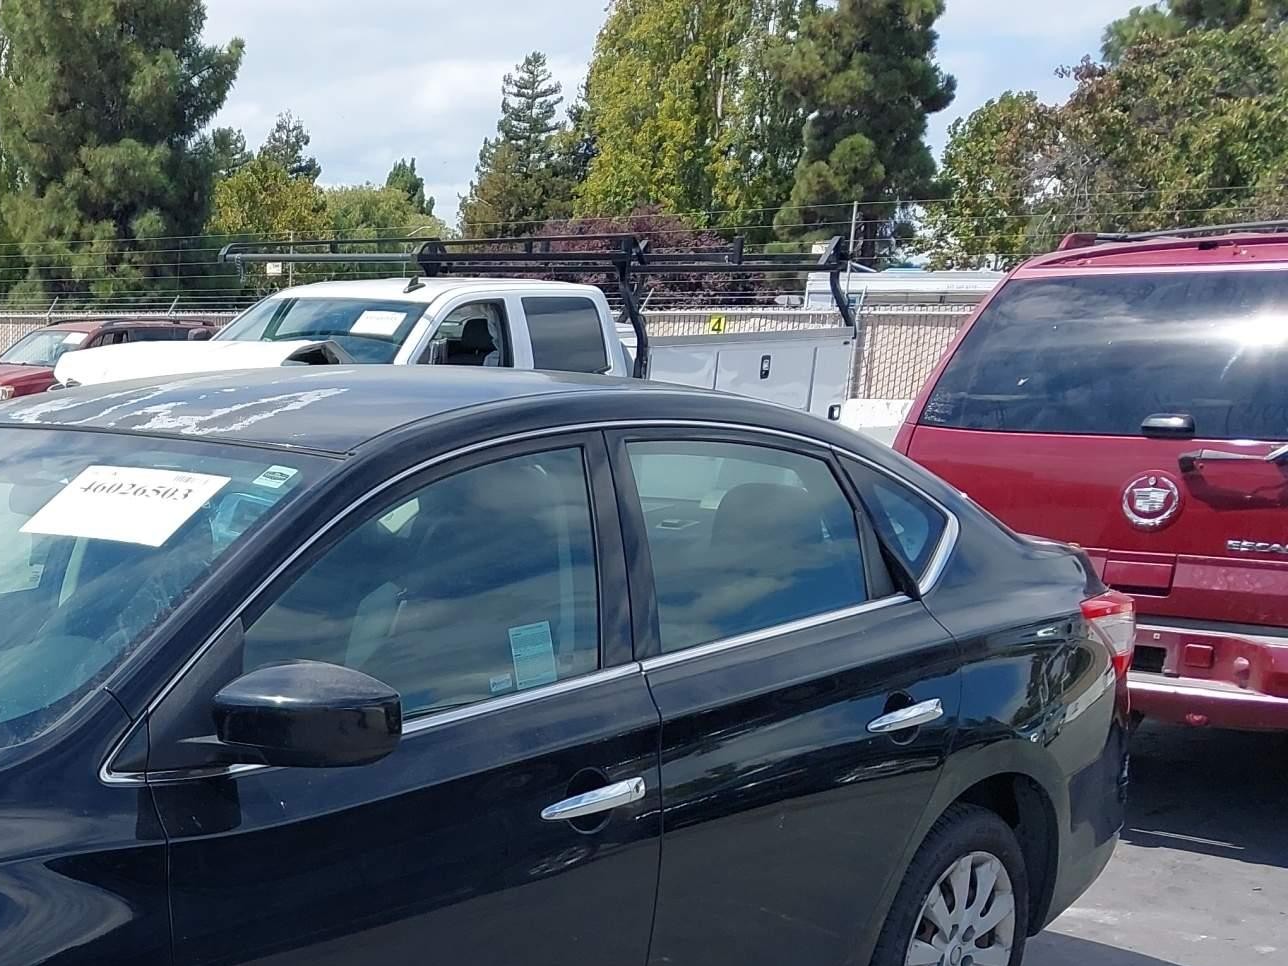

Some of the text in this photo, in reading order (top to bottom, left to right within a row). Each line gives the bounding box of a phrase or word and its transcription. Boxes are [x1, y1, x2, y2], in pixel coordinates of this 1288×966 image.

[712, 317, 722, 334] 4
[80, 481, 193, 501] 46026503
[1227, 540, 1288, 554] ESCA
